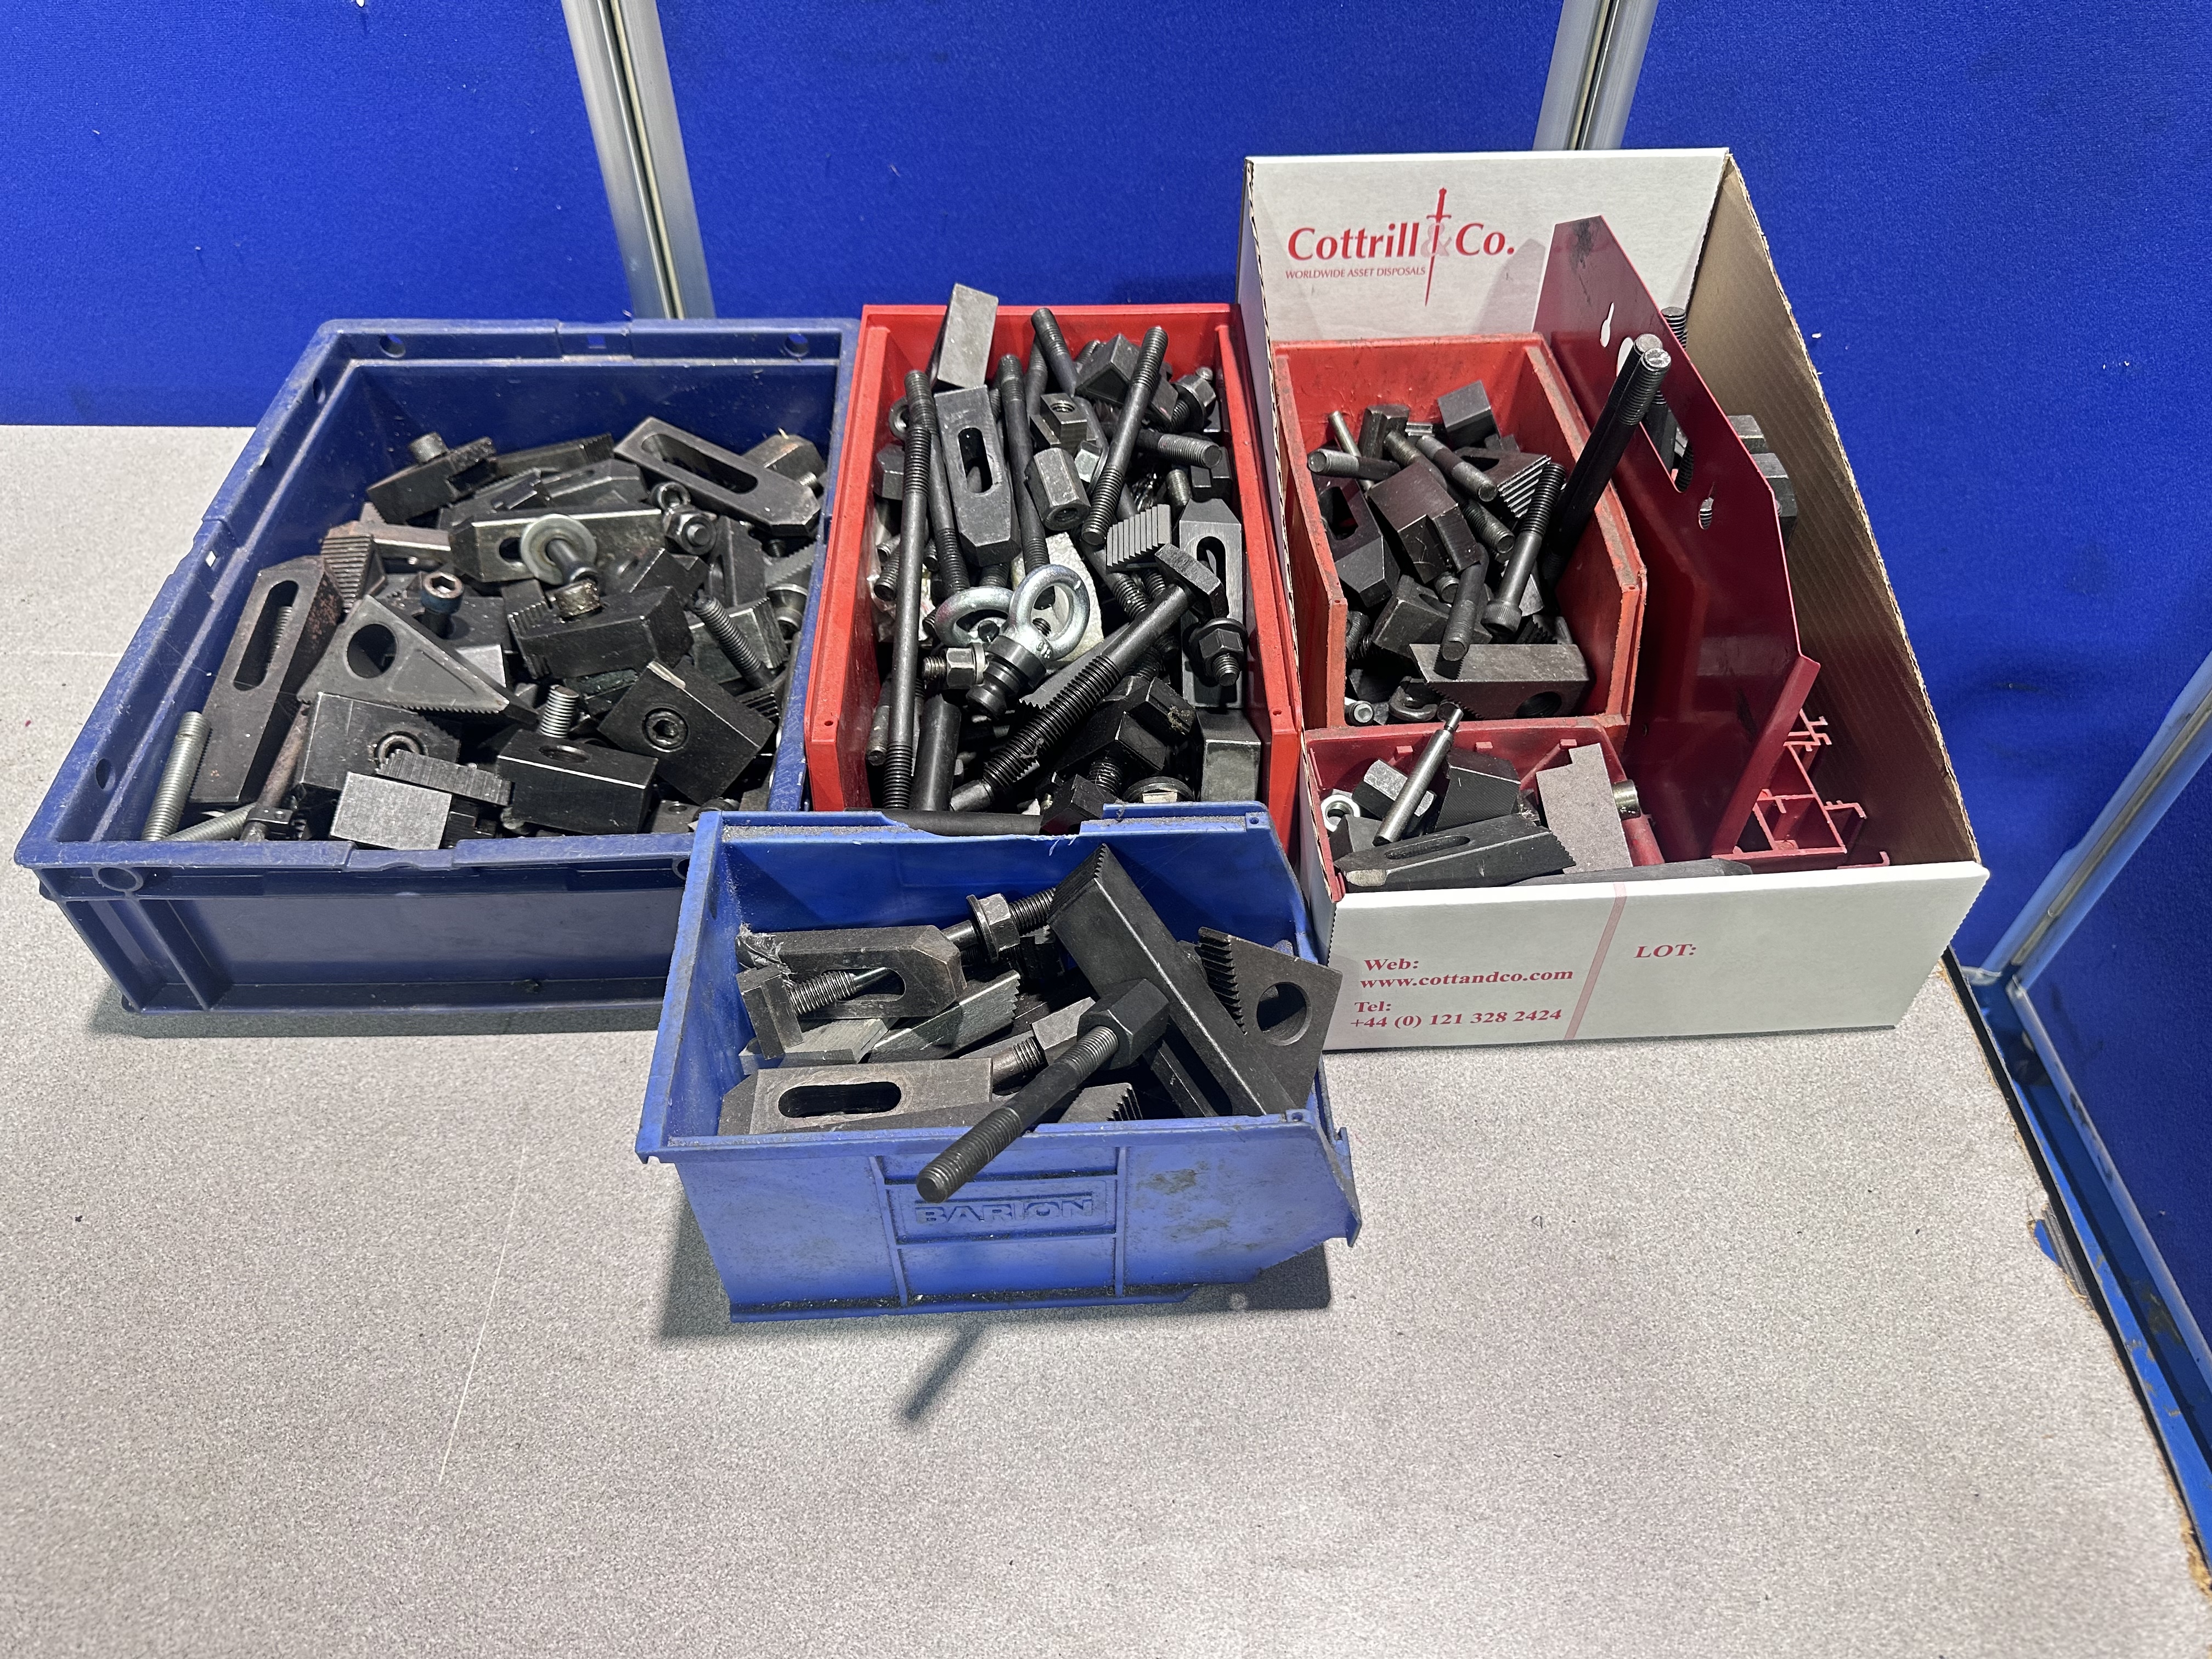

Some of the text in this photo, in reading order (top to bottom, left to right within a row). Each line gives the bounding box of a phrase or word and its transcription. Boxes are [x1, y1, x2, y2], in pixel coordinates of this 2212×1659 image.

[1287, 221, 1515, 261] Cottrill & Co.
[1285, 266, 1426, 279] WORLDWIDE ASSET DISPOSALS
[1633, 943, 1697, 958] LOT:
[1364, 958, 1419, 972] Web:
[1360, 970, 1573, 989] www.cottandco.com
[1354, 1001, 1392, 1013] Tel:
[1350, 1009, 1562, 1029] +44 (0) 121 328 2424
